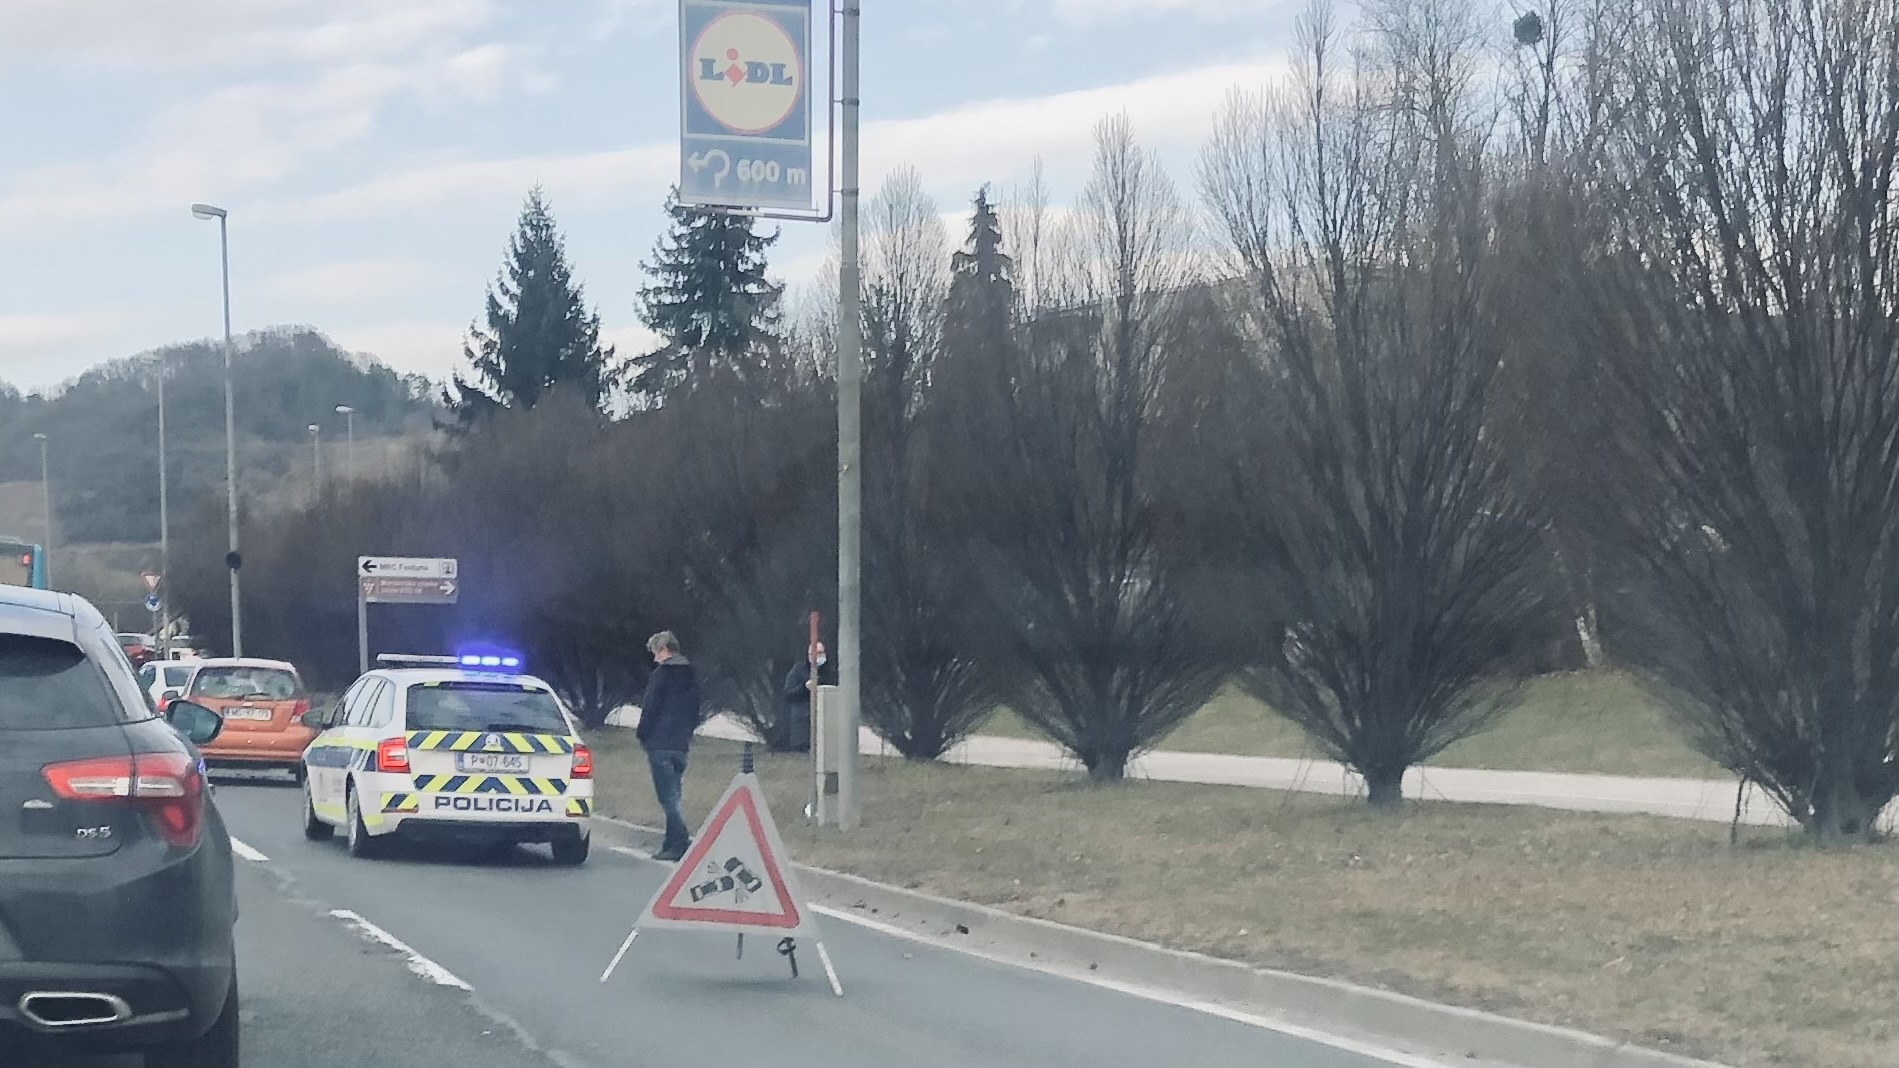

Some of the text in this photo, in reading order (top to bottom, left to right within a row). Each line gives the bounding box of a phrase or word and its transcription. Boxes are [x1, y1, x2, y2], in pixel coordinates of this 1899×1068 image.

[737, 159, 806, 185] 600 m
[434, 796, 553, 813] POLICIJA
